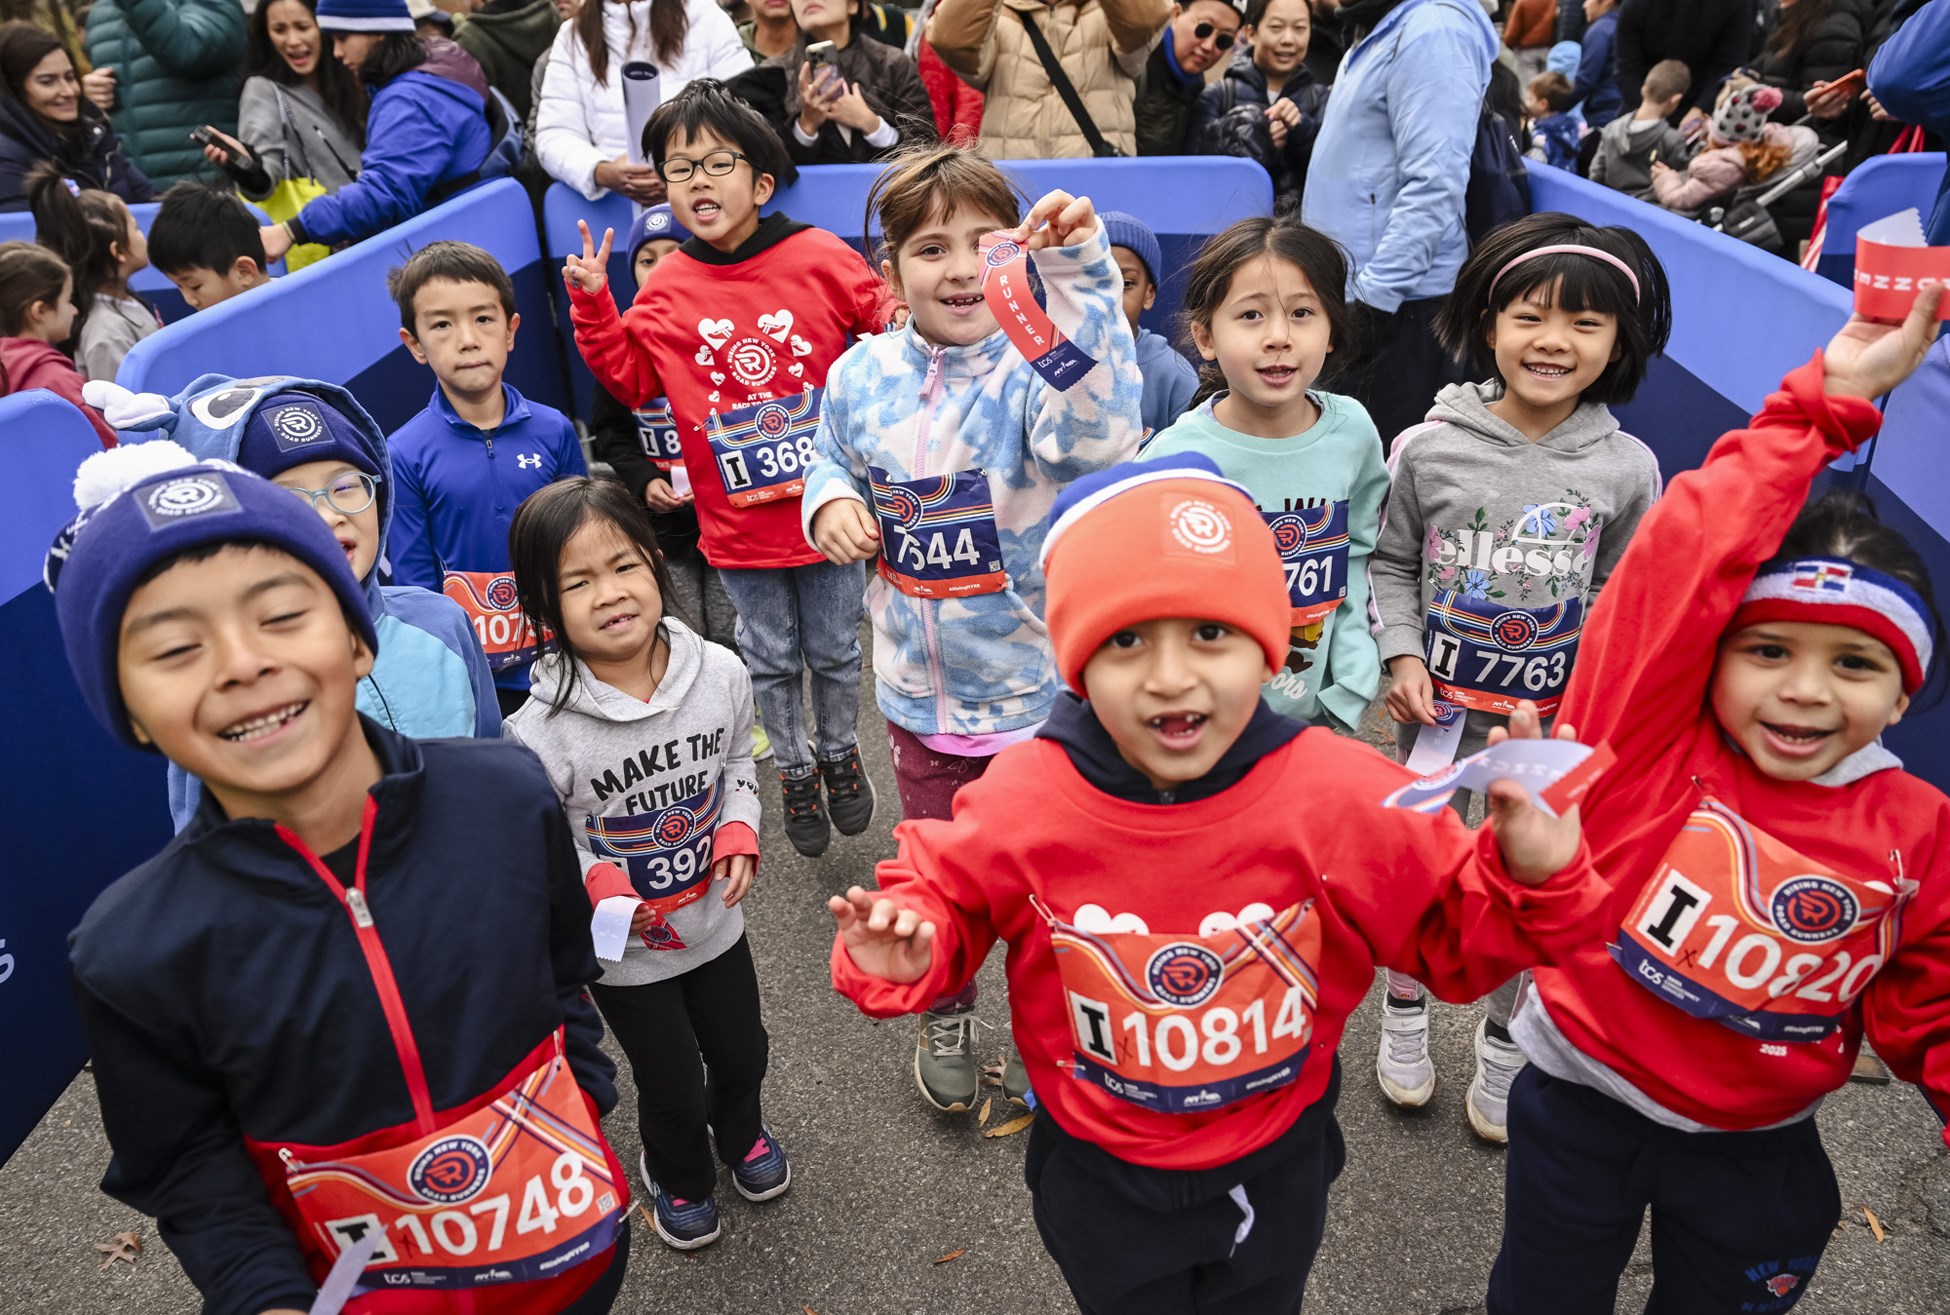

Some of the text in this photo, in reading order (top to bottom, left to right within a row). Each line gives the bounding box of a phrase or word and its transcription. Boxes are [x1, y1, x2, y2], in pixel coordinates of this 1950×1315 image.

[999, 275, 1044, 346] RUNNER
[742, 337, 759, 345] NEW
[761, 341, 776, 358] YORK
[731, 366, 777, 387] ROAD RUNNERS
[747, 391, 773, 401] AT THE
[642, 430, 657, 453] I
[726, 456, 748, 487] I
[757, 436, 814, 478] 368
[905, 492, 919, 506] YORK
[1494, 615, 1511, 628] RISING
[1526, 618, 1536, 632] YORK
[1494, 633, 1533, 649] ROAD RUNNERS
[1434, 639, 1566, 692] I 7763
[590, 727, 725, 802] MAKE THE
[625, 770, 708, 816] FUTURE
[646, 835, 713, 890] 392
[1783, 881, 1853, 921] RISING NEW YORK
[1776, 904, 1840, 940] ROAD RUNNERS
[1175, 947, 1199, 957] NEW
[1646, 884, 1700, 950] I
[1697, 914, 1886, 1003] 10820
[1638, 959, 1664, 985] tcs
[1080, 984, 1307, 1073] I 10814
[413, 1140, 483, 1182] RISING NEW YORK
[394, 1150, 595, 1256] 10748
[421, 1168, 486, 1202] ROAD RUNNERS
[1744, 1260, 1781, 1283] NEW
